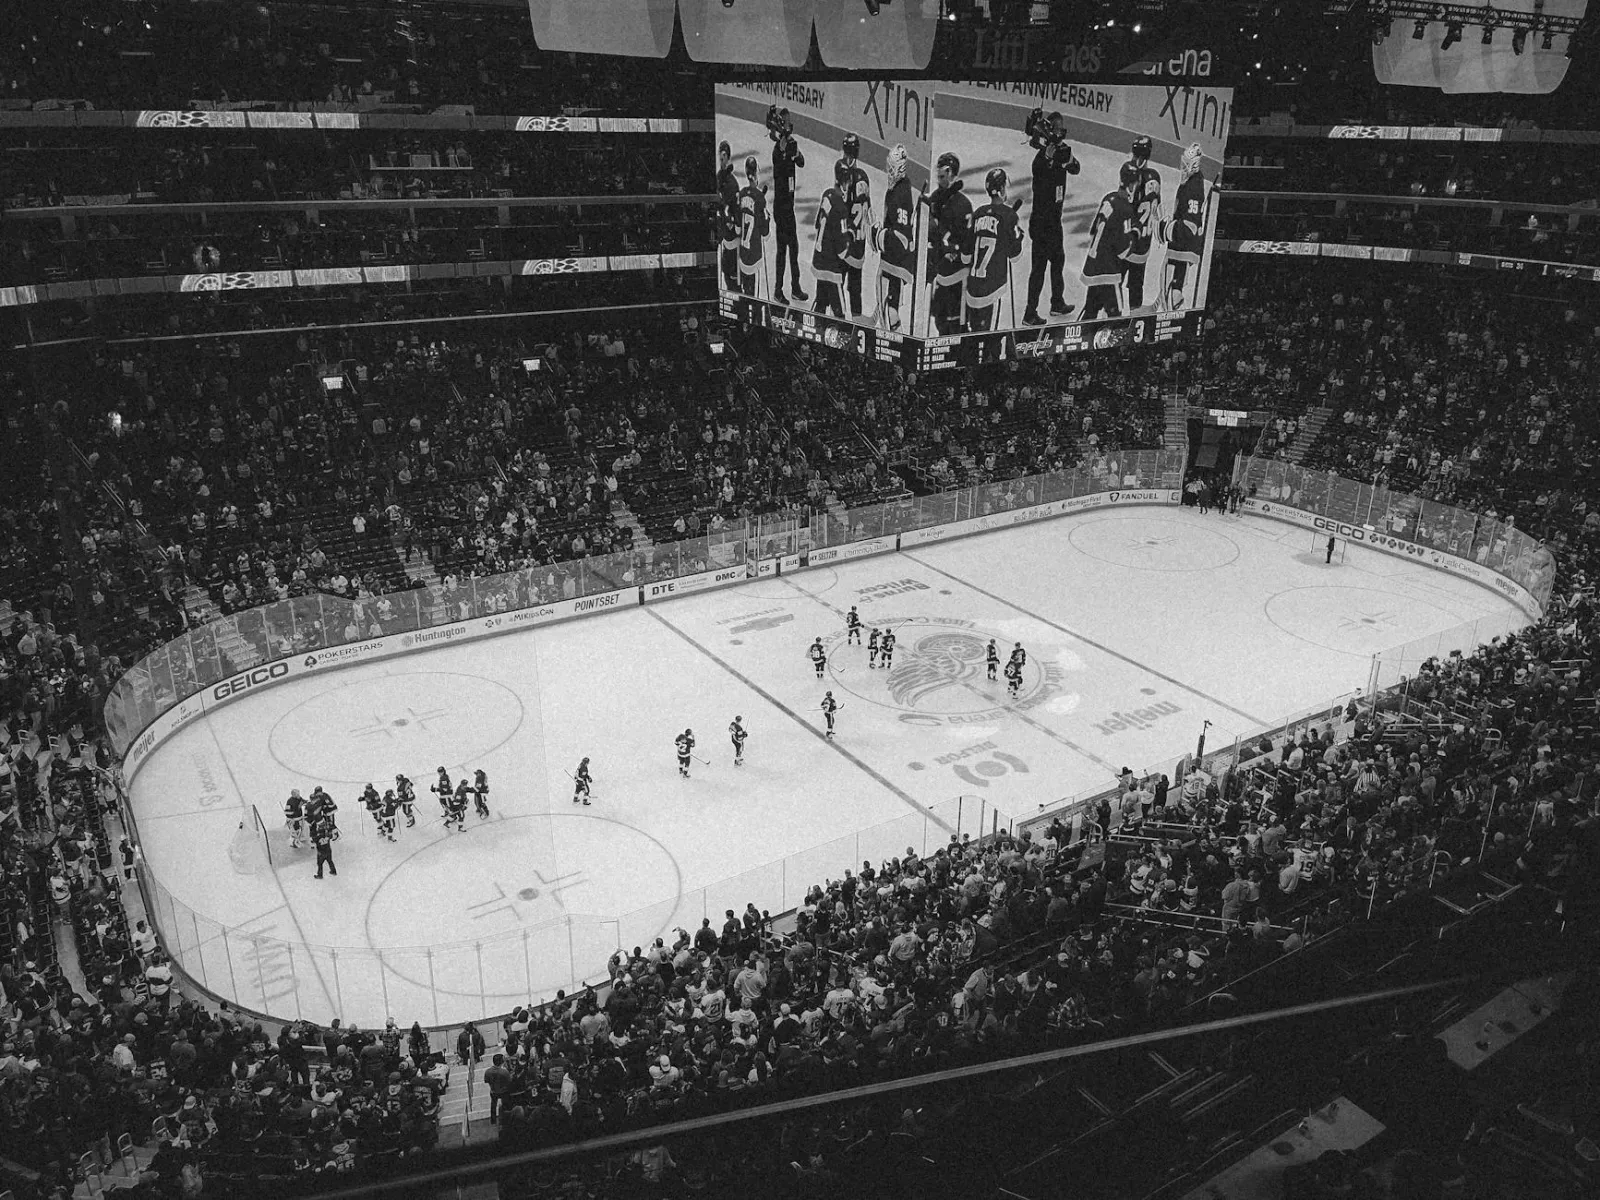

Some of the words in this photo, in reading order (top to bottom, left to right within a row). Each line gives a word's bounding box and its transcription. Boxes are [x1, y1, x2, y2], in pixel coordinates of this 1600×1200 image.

[756, 82, 825, 110] ANNIVERSARY
[1011, 83, 1114, 113] ANNIVERSARY
[1187, 199, 1199, 214] 35
[970, 236, 997, 278] 17
[761, 305, 767, 327] 1
[857, 330, 866, 354] 3
[1133, 319, 1145, 344] 3
[999, 335, 1007, 361] 1
[1121, 492, 1160, 501] FANDUEL
[1313, 516, 1365, 541] GEICO
[715, 571, 736, 582] DMC
[1495, 577, 1519, 597] meijer
[652, 582, 675, 596] DTE
[574, 593, 621, 613] POINTSBET
[414, 626, 466, 645] Huntington
[317, 641, 383, 661] POKERSTARS
[213, 661, 289, 701] GEICO
[1090, 700, 1184, 737] meijer
[132, 730, 156, 763] meijer
[1300, 861, 1314, 873] 19
